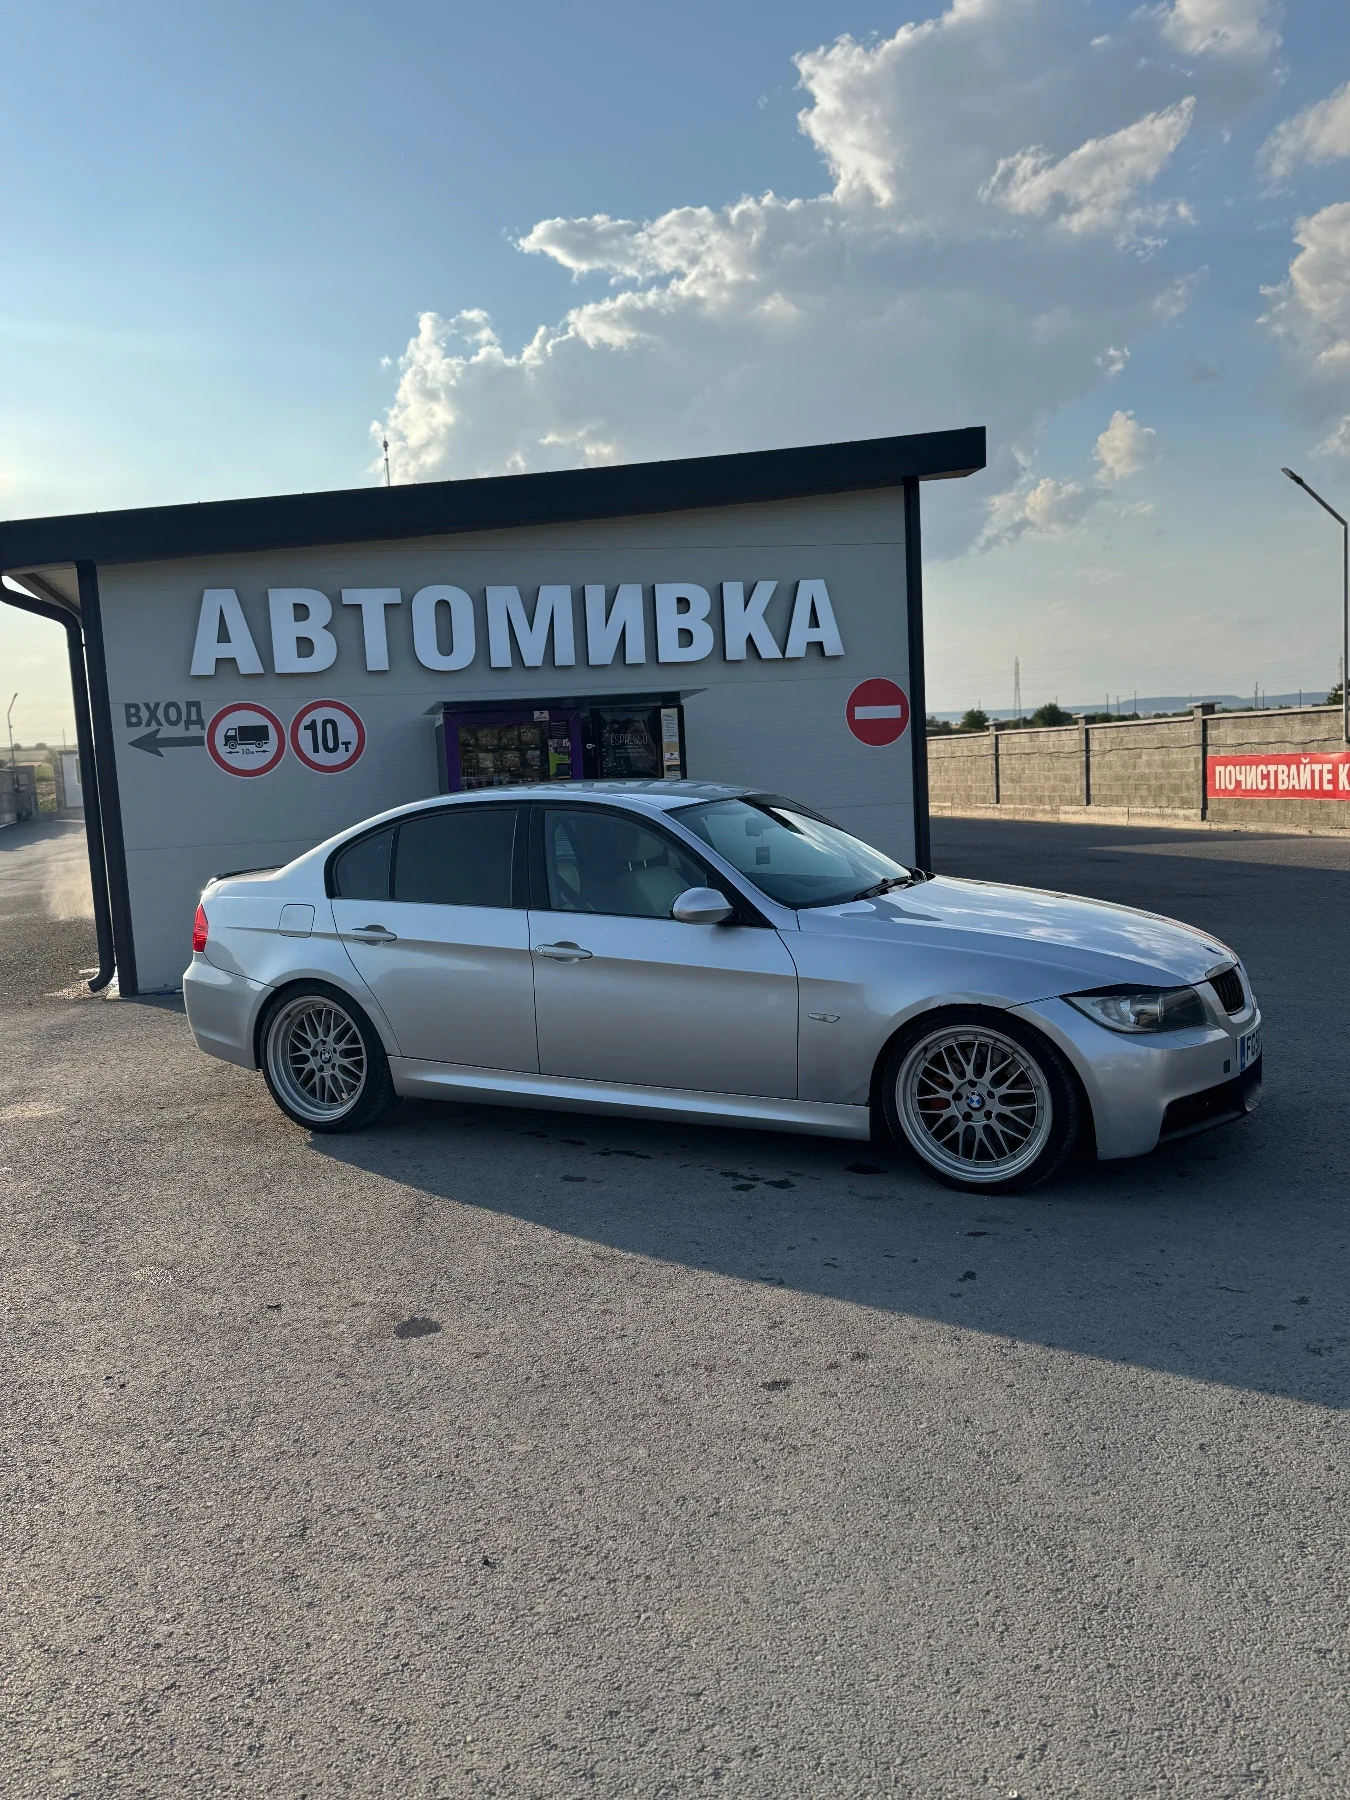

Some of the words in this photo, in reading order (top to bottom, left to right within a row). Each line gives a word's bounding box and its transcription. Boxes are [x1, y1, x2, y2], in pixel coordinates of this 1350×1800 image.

[190, 579, 845, 676] АВТОМИВКА
[124, 701, 205, 731] ВХОД
[610, 732, 648, 746] ESPRESSO
[1215, 757, 1334, 791] ПОЧИСТВАЙТЕ
